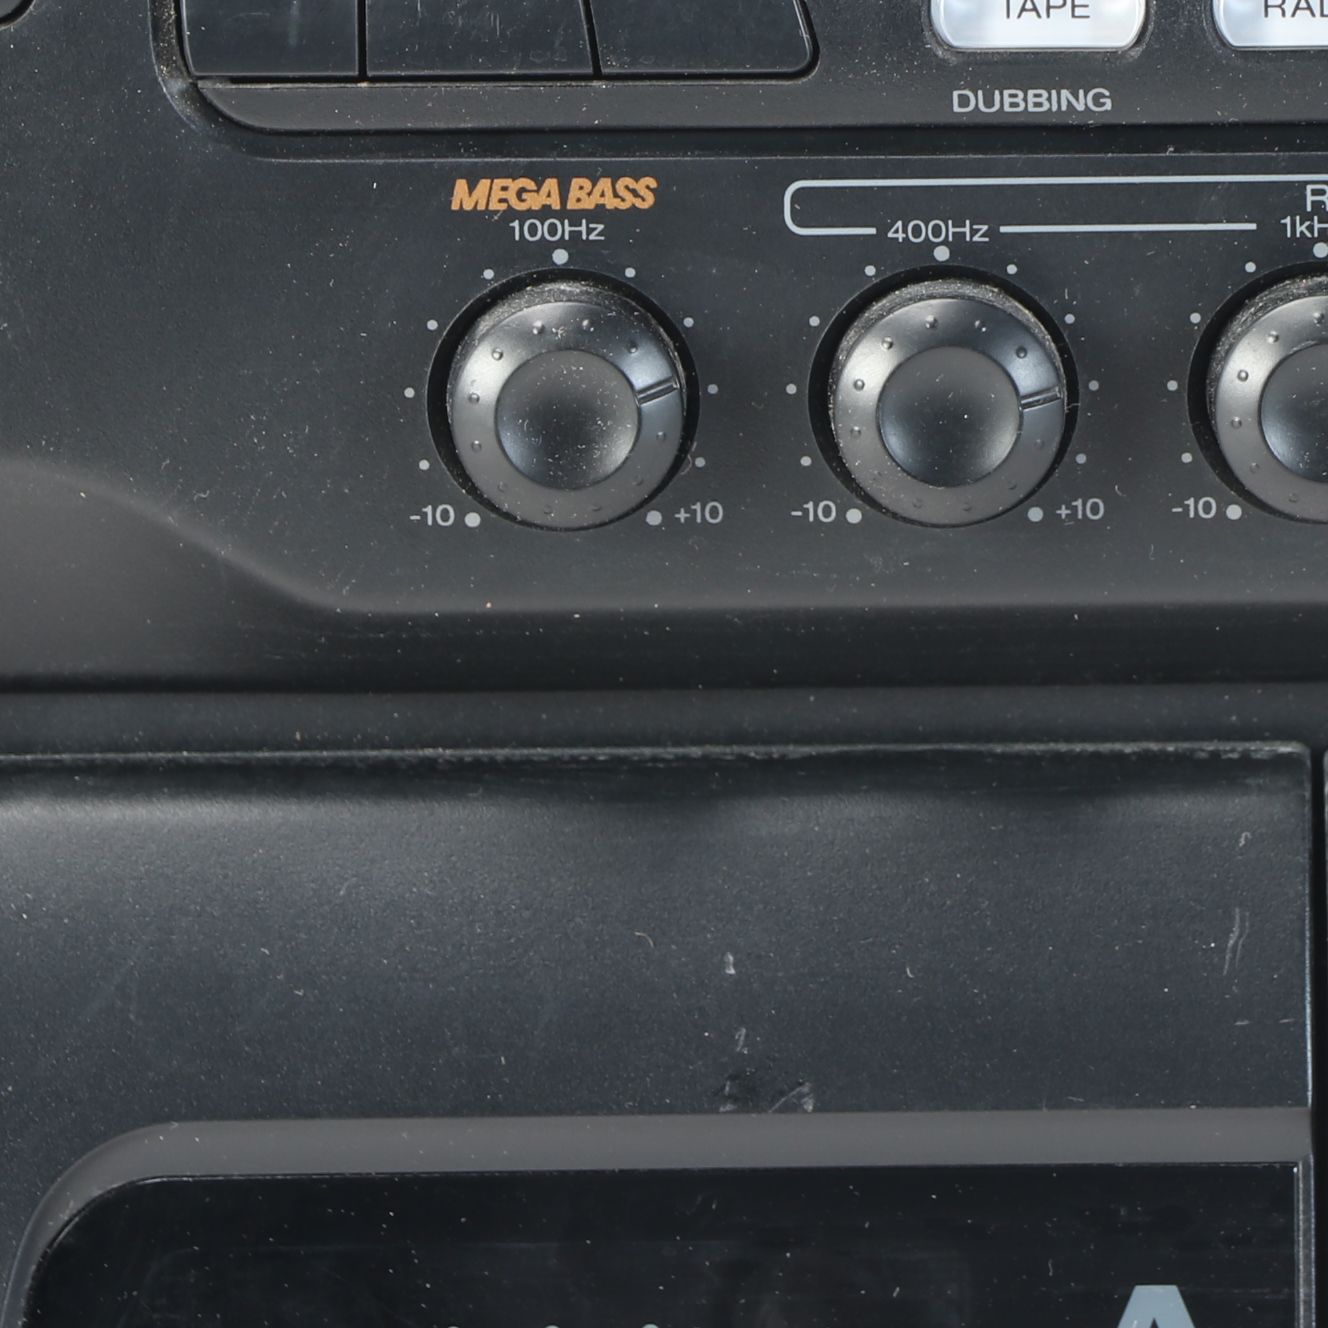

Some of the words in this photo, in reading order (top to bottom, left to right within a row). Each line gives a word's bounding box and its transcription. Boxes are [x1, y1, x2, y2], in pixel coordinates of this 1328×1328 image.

[953, 88, 1111, 112] DUBBING
[452, 179, 560, 210] MEGA
[567, 177, 656, 209] BASS
[510, 219, 604, 241] 100Hz
[888, 220, 989, 242] 400Hz
[410, 505, 454, 526] -10
[675, 502, 723, 523] +10
[791, 501, 836, 522] -10
[1057, 498, 1104, 520] +10
[1172, 497, 1216, 518] -10
